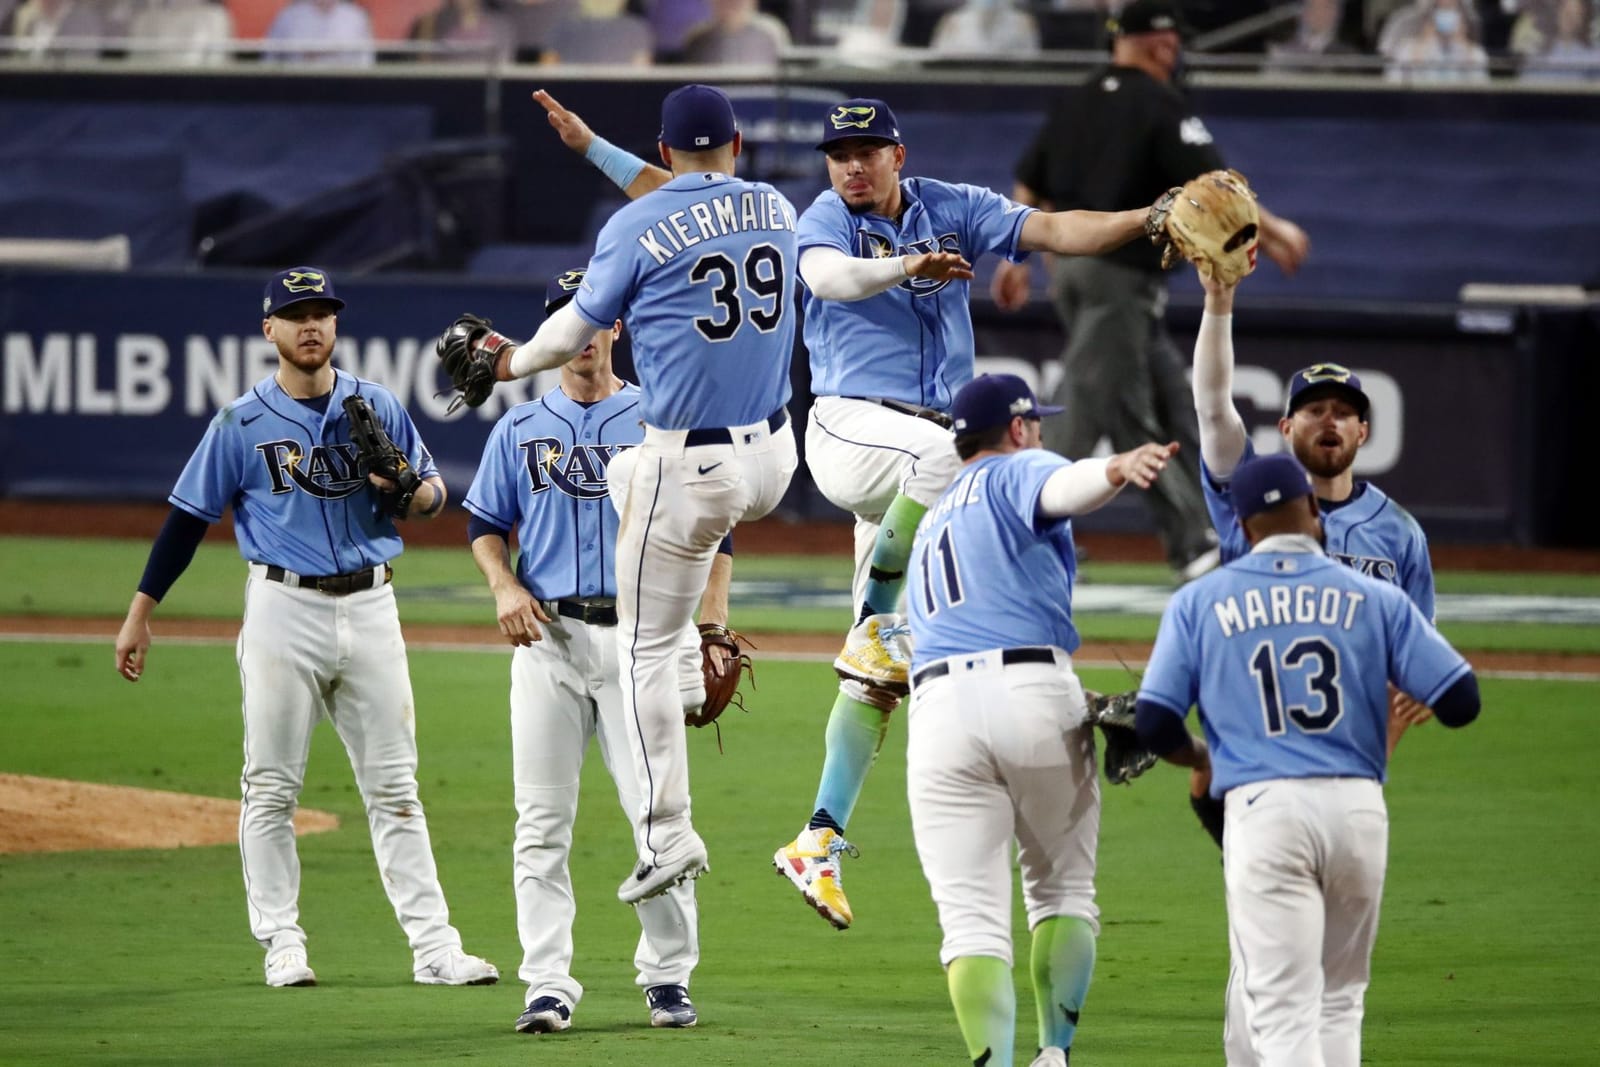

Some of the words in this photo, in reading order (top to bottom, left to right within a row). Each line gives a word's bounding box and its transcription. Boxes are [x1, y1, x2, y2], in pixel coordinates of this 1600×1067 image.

[638, 192, 796, 265] KIERMAIER
[857, 227, 962, 297] RYS
[688, 242, 786, 343] 39
[3, 333, 172, 415] MLB
[185, 334, 562, 424] NEWO
[256, 439, 368, 499] RAY
[519, 437, 640, 499] RAY
[920, 521, 966, 619] 11
[1213, 584, 1365, 637] MARGOT
[1248, 635, 1344, 737] 13
